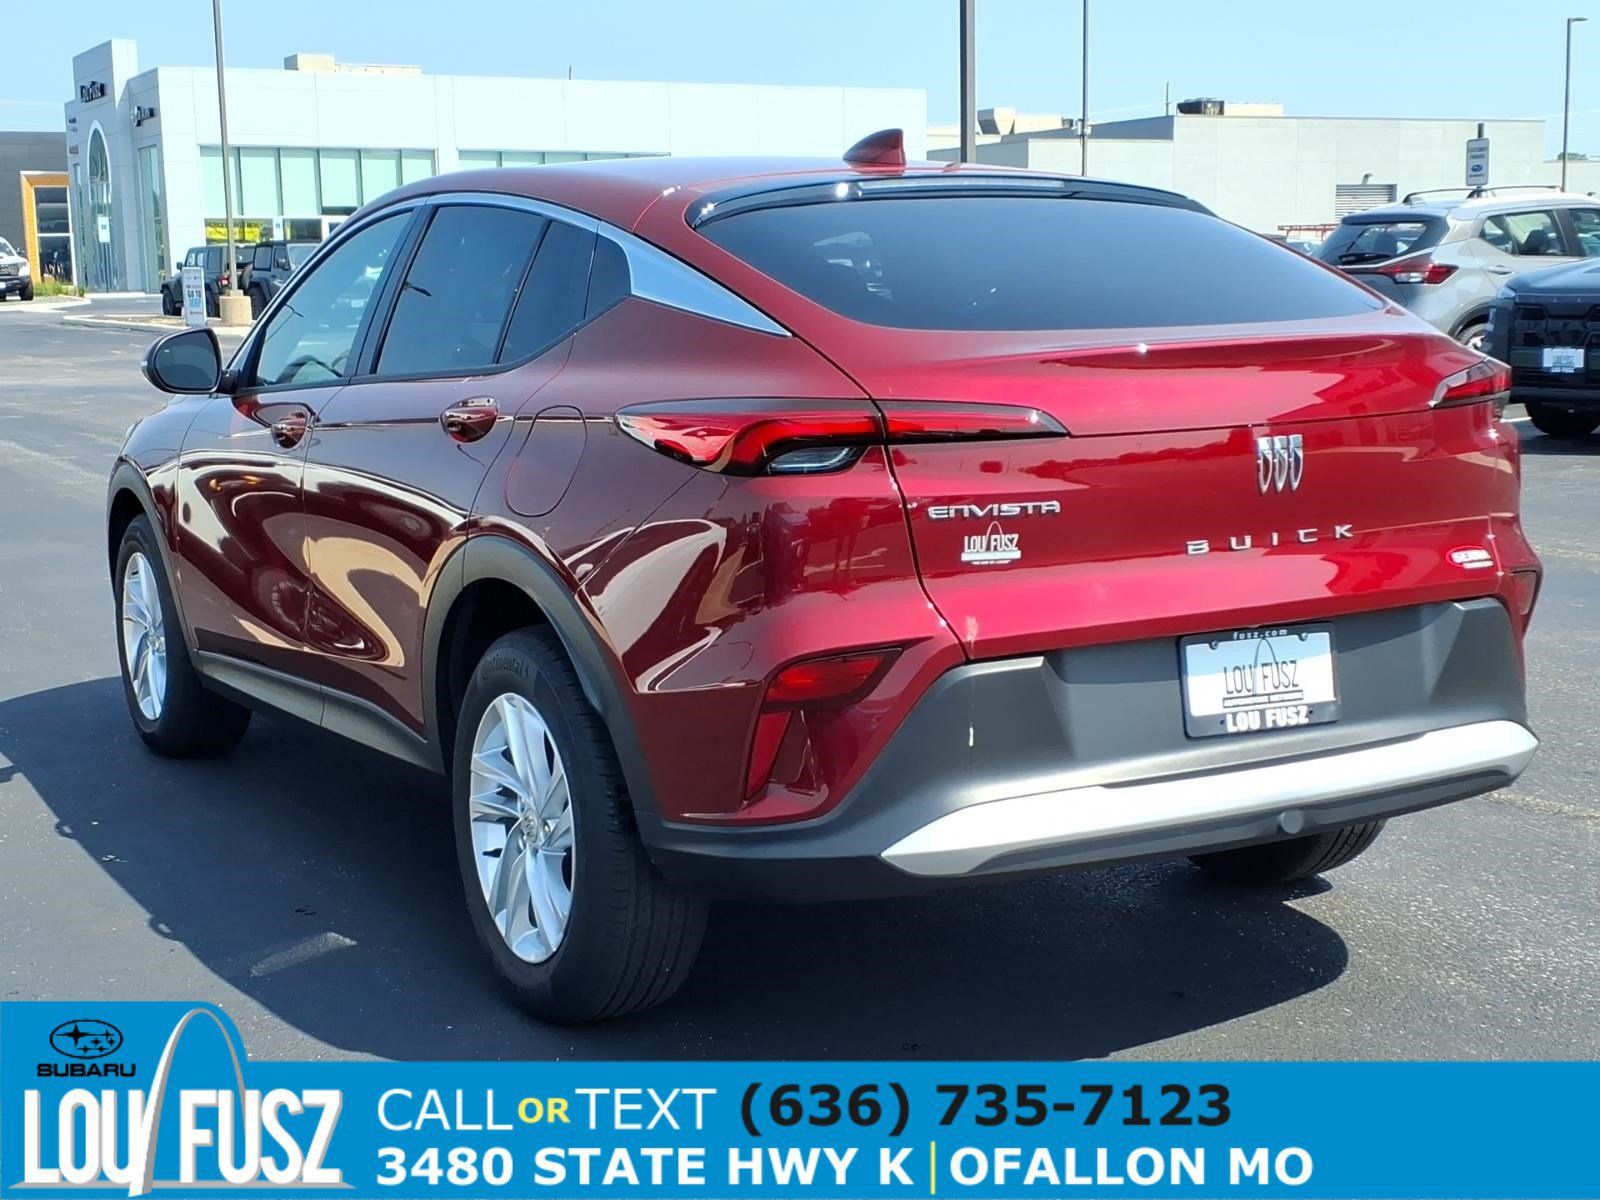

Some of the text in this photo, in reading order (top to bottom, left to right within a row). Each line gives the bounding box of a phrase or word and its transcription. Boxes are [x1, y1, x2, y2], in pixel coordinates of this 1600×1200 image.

[927, 499, 1061, 521] ENVISTA
[964, 533, 1019, 553] LOU FUSZ
[1186, 524, 1355, 556] BUICK
[1223, 659, 1300, 695] LOU FUSZ
[1226, 704, 1310, 733] LOU FUSZ
